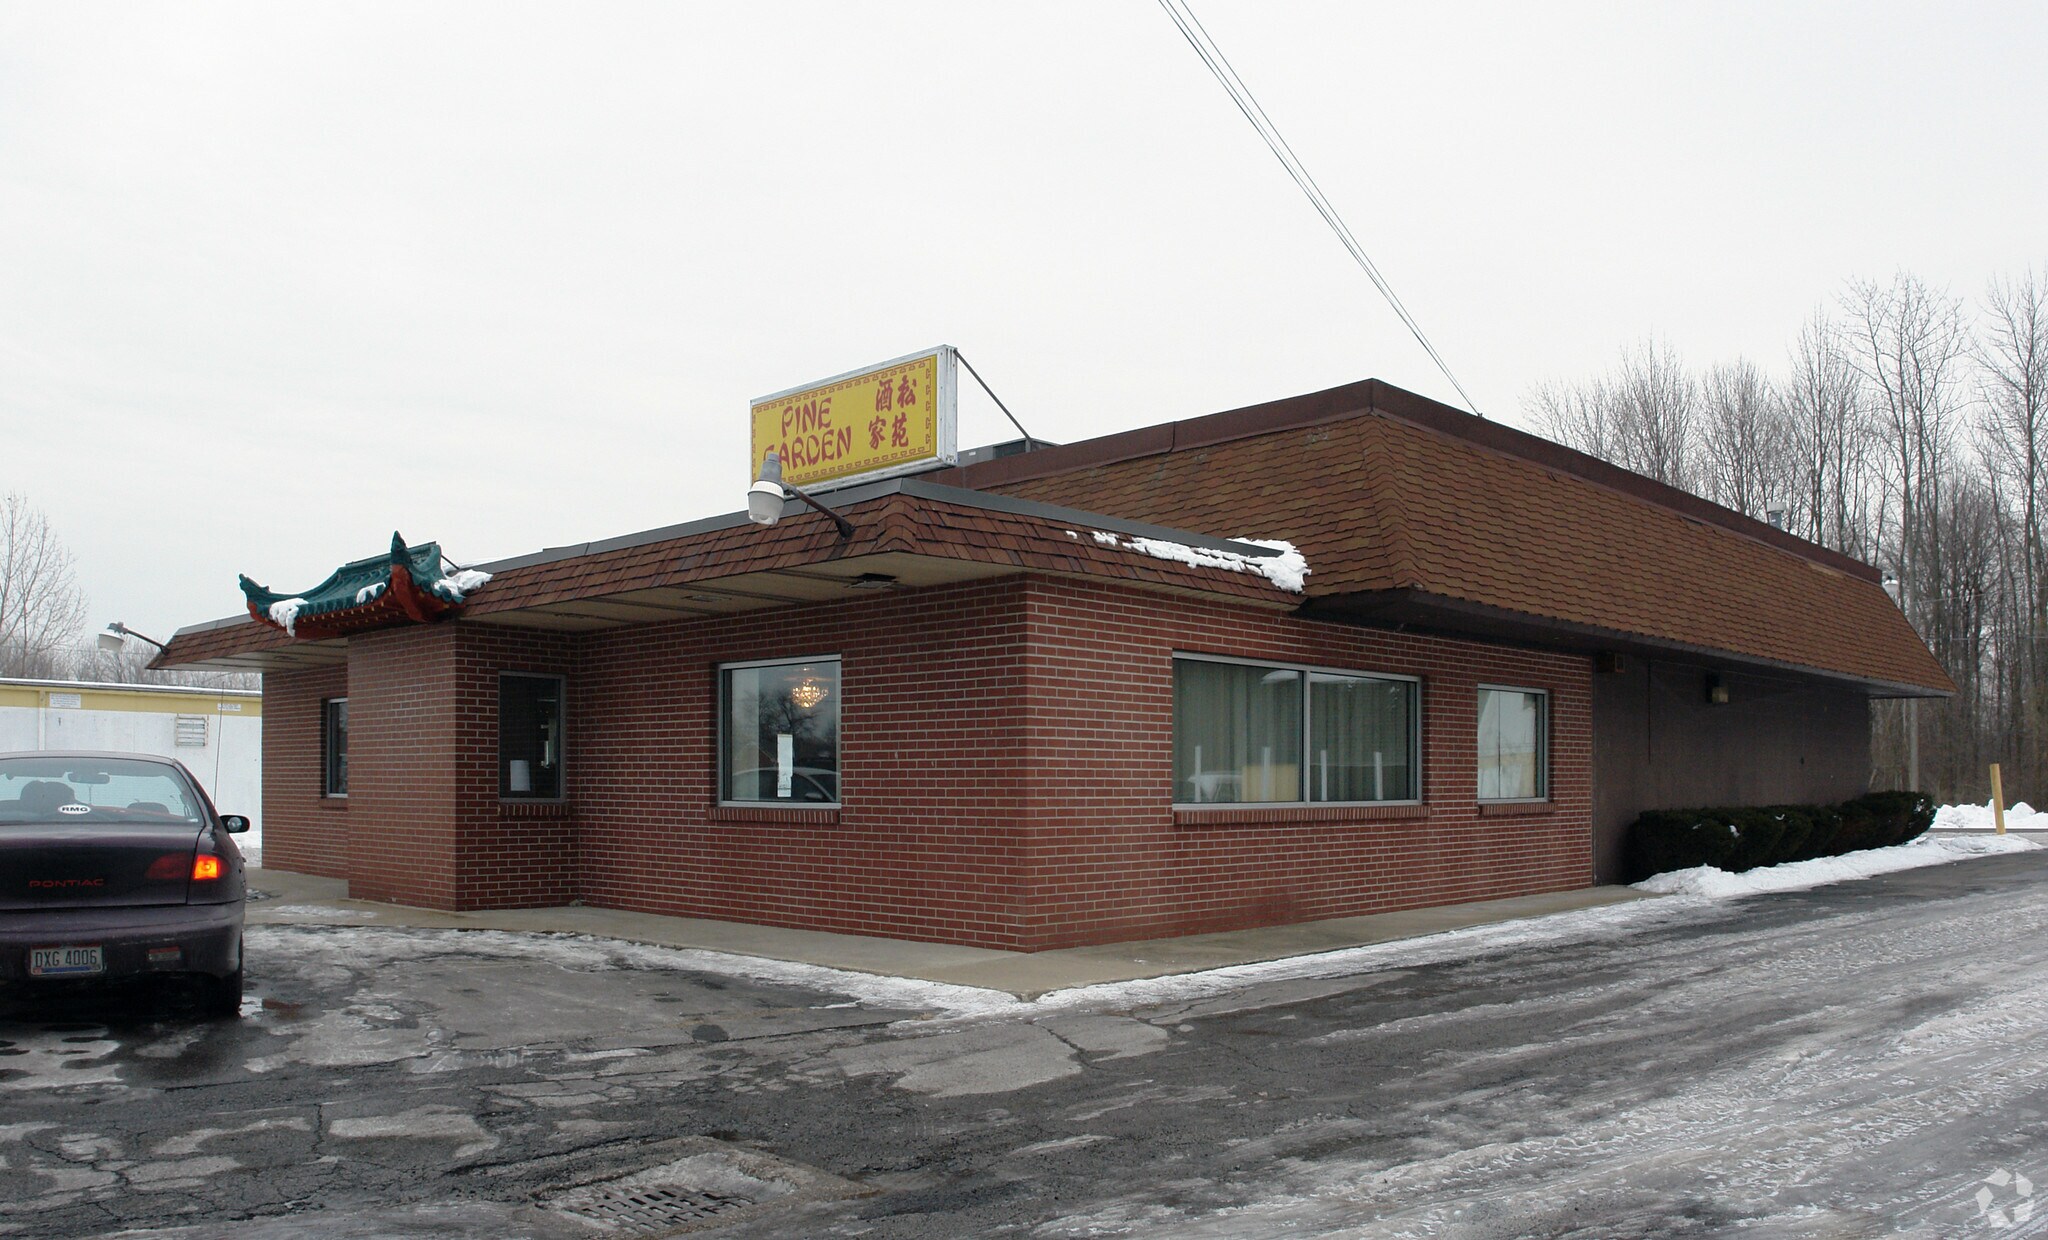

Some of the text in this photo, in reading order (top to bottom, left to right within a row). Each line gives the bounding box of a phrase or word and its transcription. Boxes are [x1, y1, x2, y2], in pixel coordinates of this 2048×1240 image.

[781, 397, 832, 438] PINE
[61, 805, 88, 813] RMG
[28, 878, 104, 888] PONTIAC
[35, 948, 97, 968] DXG 4006
